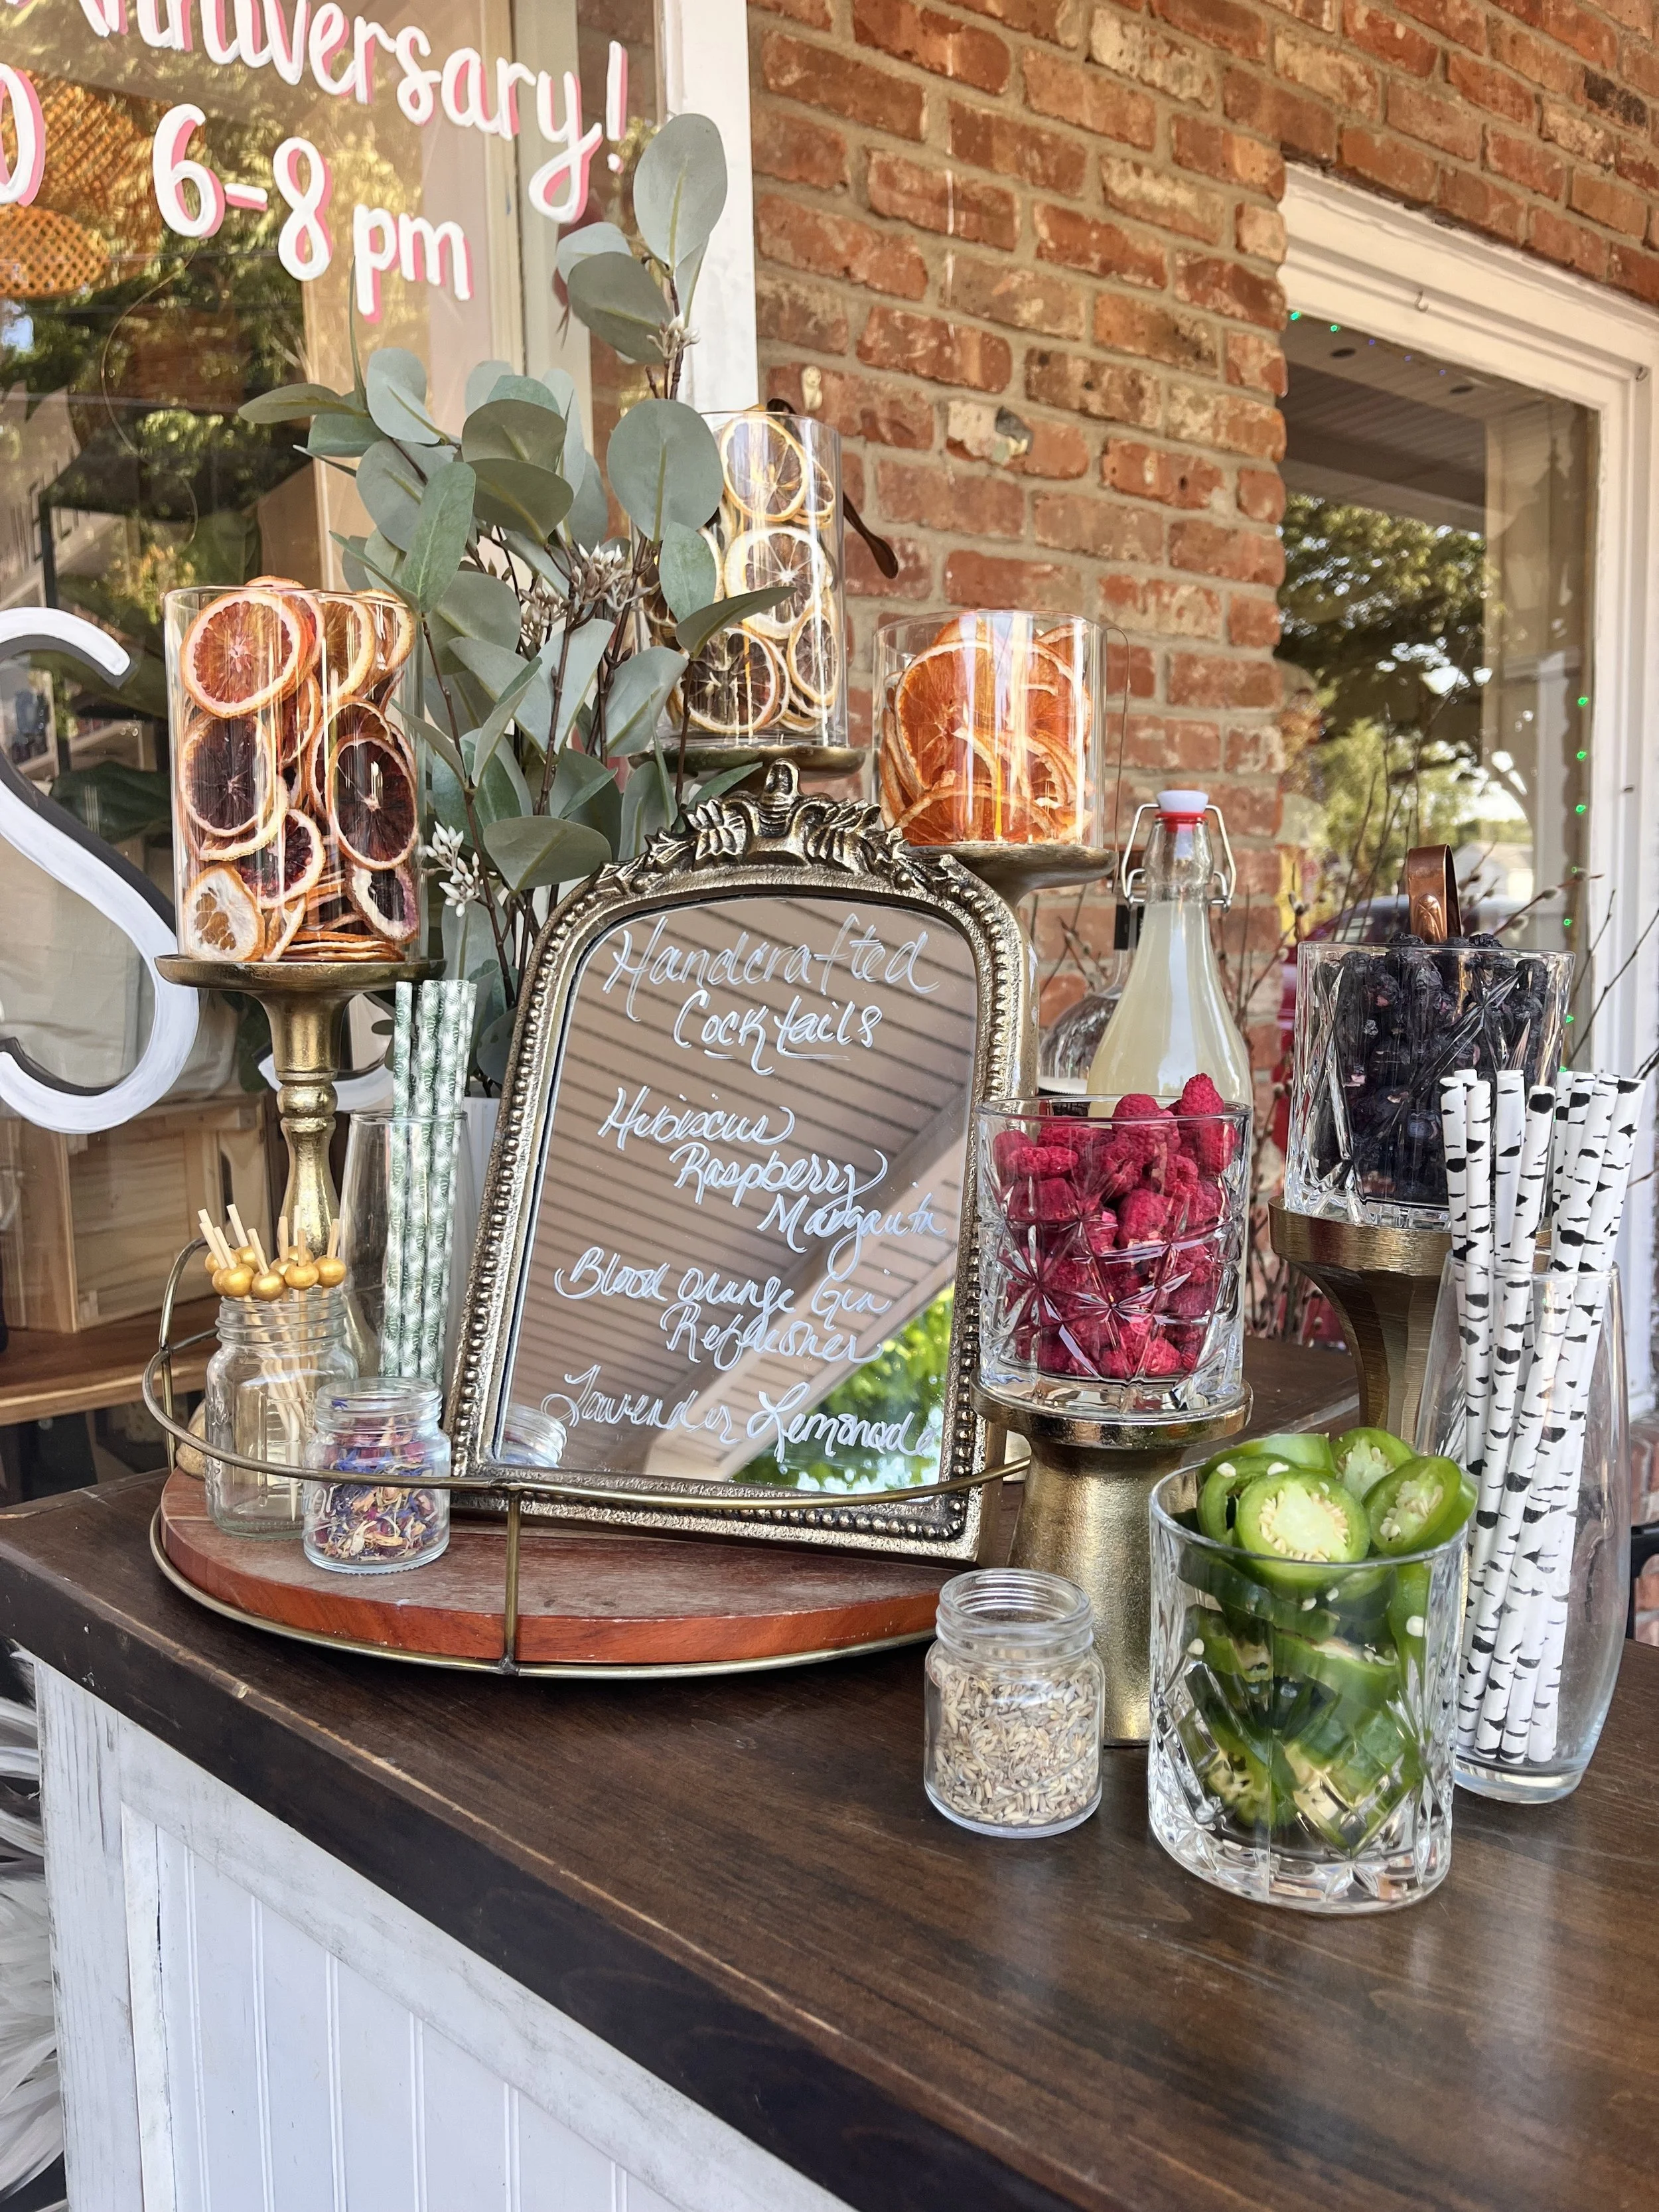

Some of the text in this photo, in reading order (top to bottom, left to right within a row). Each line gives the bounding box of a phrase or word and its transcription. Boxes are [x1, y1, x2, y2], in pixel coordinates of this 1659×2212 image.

[153, 103, 332, 281] 6-8
[353, 203, 474, 323] pm
[603, 913, 940, 1023] Handcrafted
[674, 989, 883, 1076] Cocktails
[597, 1085, 796, 1150] Hibiscus
[669, 1142, 889, 1215] Raspberry
[555, 1246, 668, 1301] Blood
[811, 1272, 893, 1331] Gin
[660, 1301, 885, 1372] Refresher
[541, 1364, 936, 1463] Lavender Lemonade
